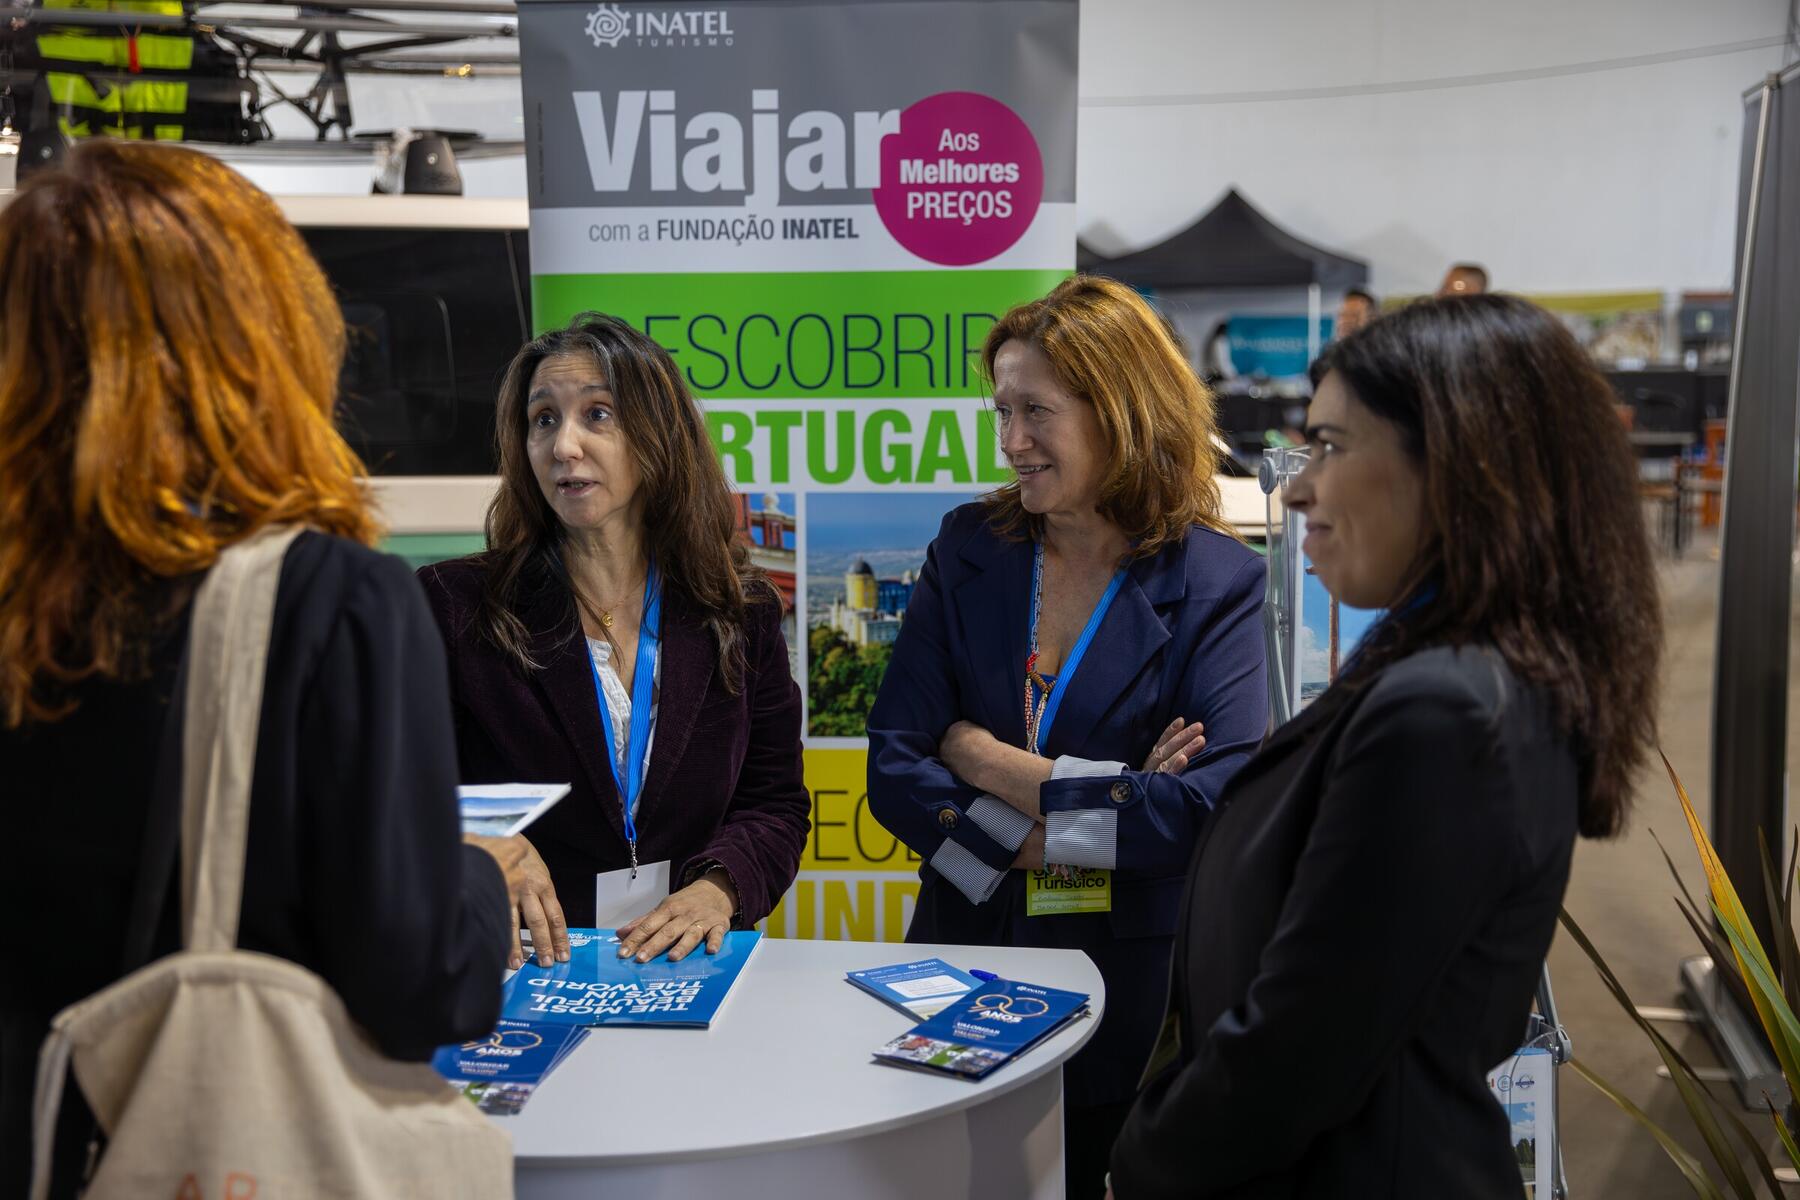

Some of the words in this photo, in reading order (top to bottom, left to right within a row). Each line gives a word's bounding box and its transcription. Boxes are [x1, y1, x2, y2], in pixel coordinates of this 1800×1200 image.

[636, 11, 734, 36] INATEL
[636, 38, 734, 47] TURISMO
[938, 128, 980, 151] Aos
[572, 89, 900, 208] Viajar
[900, 158, 1020, 184] Melhores
[907, 190, 1013, 226] PREÇOS
[589, 223, 630, 242] com
[638, 223, 649, 241] a
[657, 214, 774, 246] FUNDAÇÃO
[783, 218, 859, 240] INATEL
[703, 409, 1012, 484] RTUGAL
[528, 978, 638, 991] WORLD
[649, 981, 703, 990] THE
[584, 990, 614, 999] IN
[625, 988, 700, 998] BAYS
[530, 994, 695, 1007] BEAUTIFUL
[530, 1003, 622, 1014] MOST
[628, 1003, 689, 1013] THE
[979, 1010, 1023, 1023] ANOS
